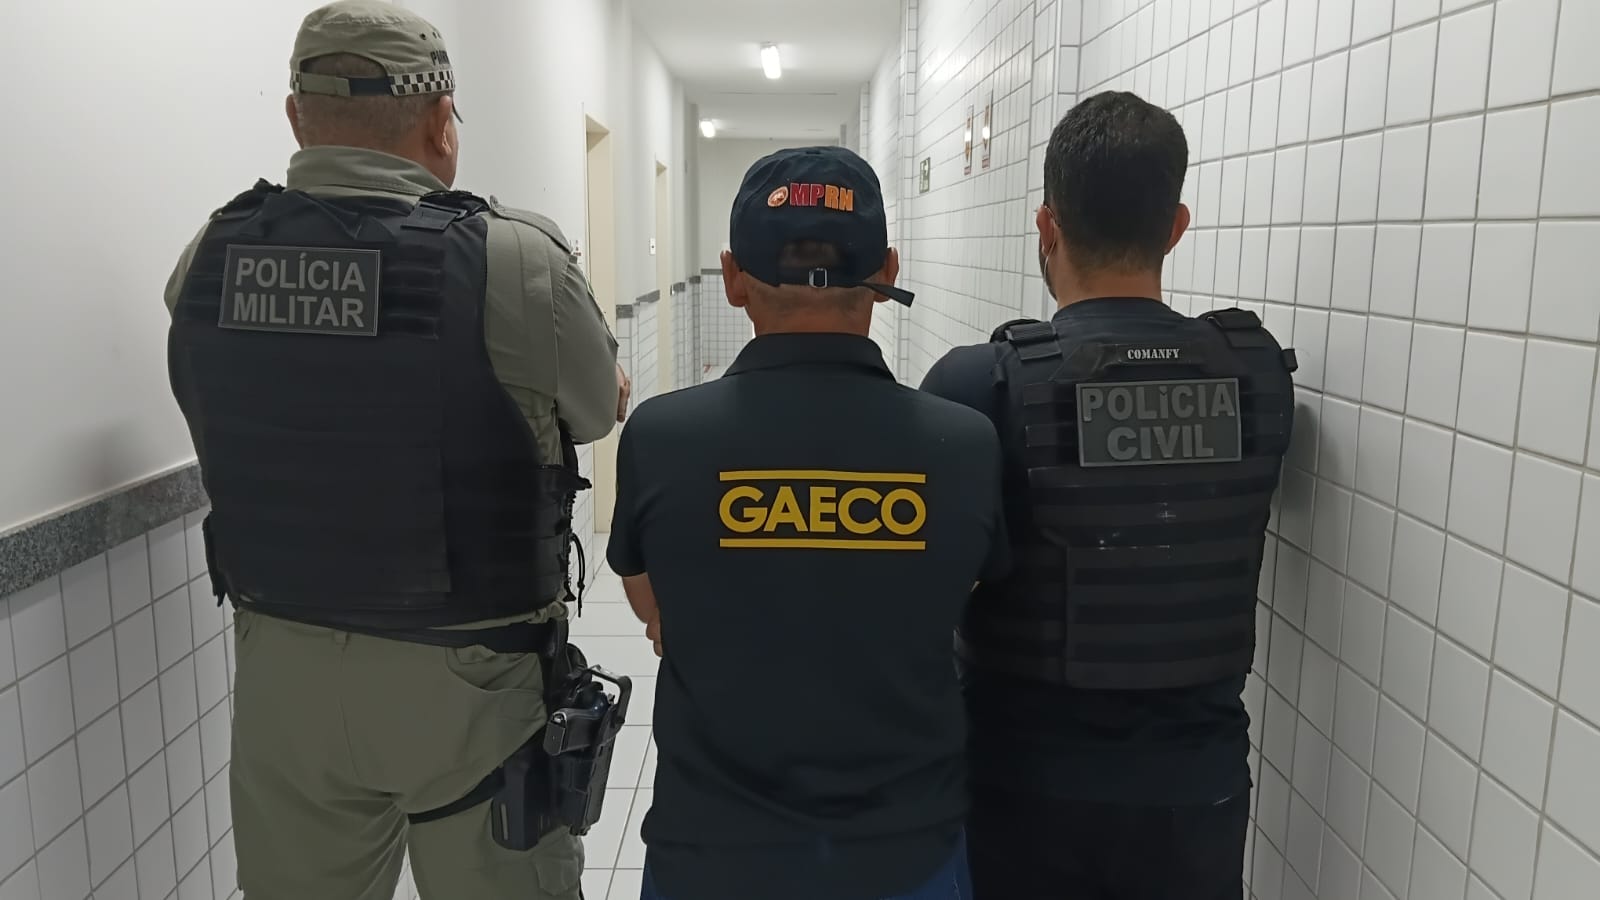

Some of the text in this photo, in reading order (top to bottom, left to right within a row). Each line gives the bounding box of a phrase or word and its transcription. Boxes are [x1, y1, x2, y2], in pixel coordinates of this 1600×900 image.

[790, 183, 853, 211] MPRN
[235, 252, 366, 292] POLÍCIA
[233, 292, 364, 328] MILITAR
[1107, 424, 1215, 461] CIVIL
[719, 485, 927, 535] GAECO
